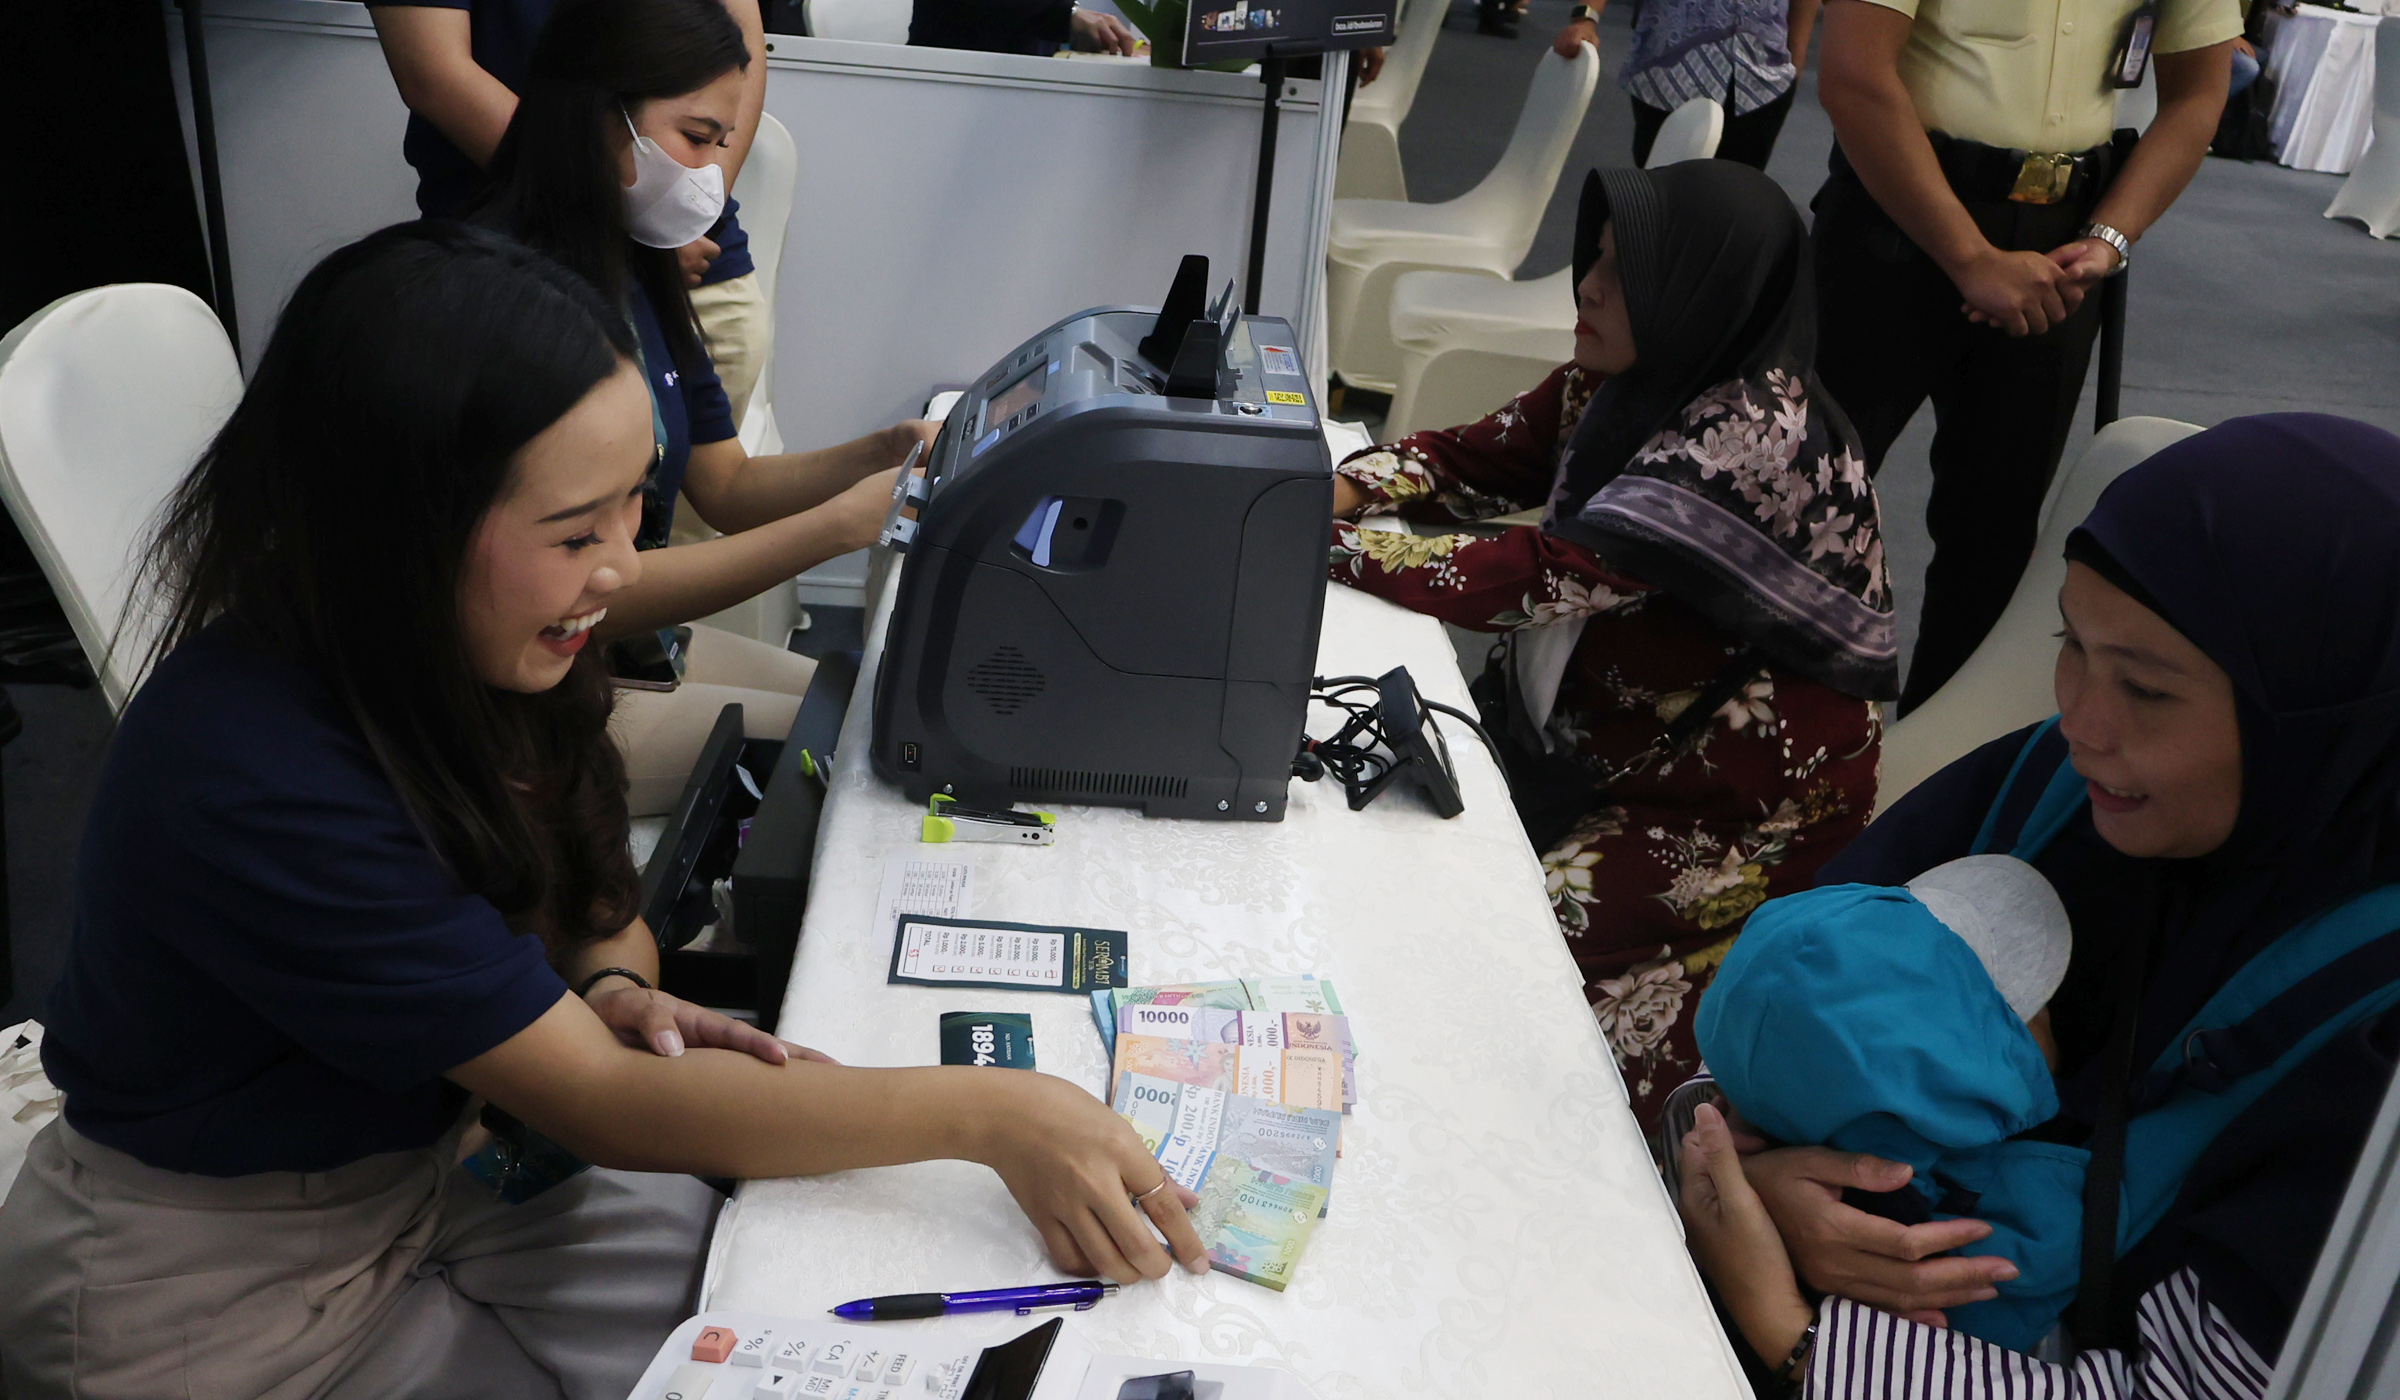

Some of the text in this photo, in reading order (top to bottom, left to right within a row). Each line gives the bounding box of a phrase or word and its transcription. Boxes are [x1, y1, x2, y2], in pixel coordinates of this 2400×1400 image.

[924, 930, 932, 946] TOTAL
[1139, 1010, 1189, 1024] 10000
[972, 1024, 996, 1066] 1894
[1211, 1091, 1222, 1115] BANK
[825, 1344, 845, 1361] CA
[891, 1353, 907, 1373] FEED
